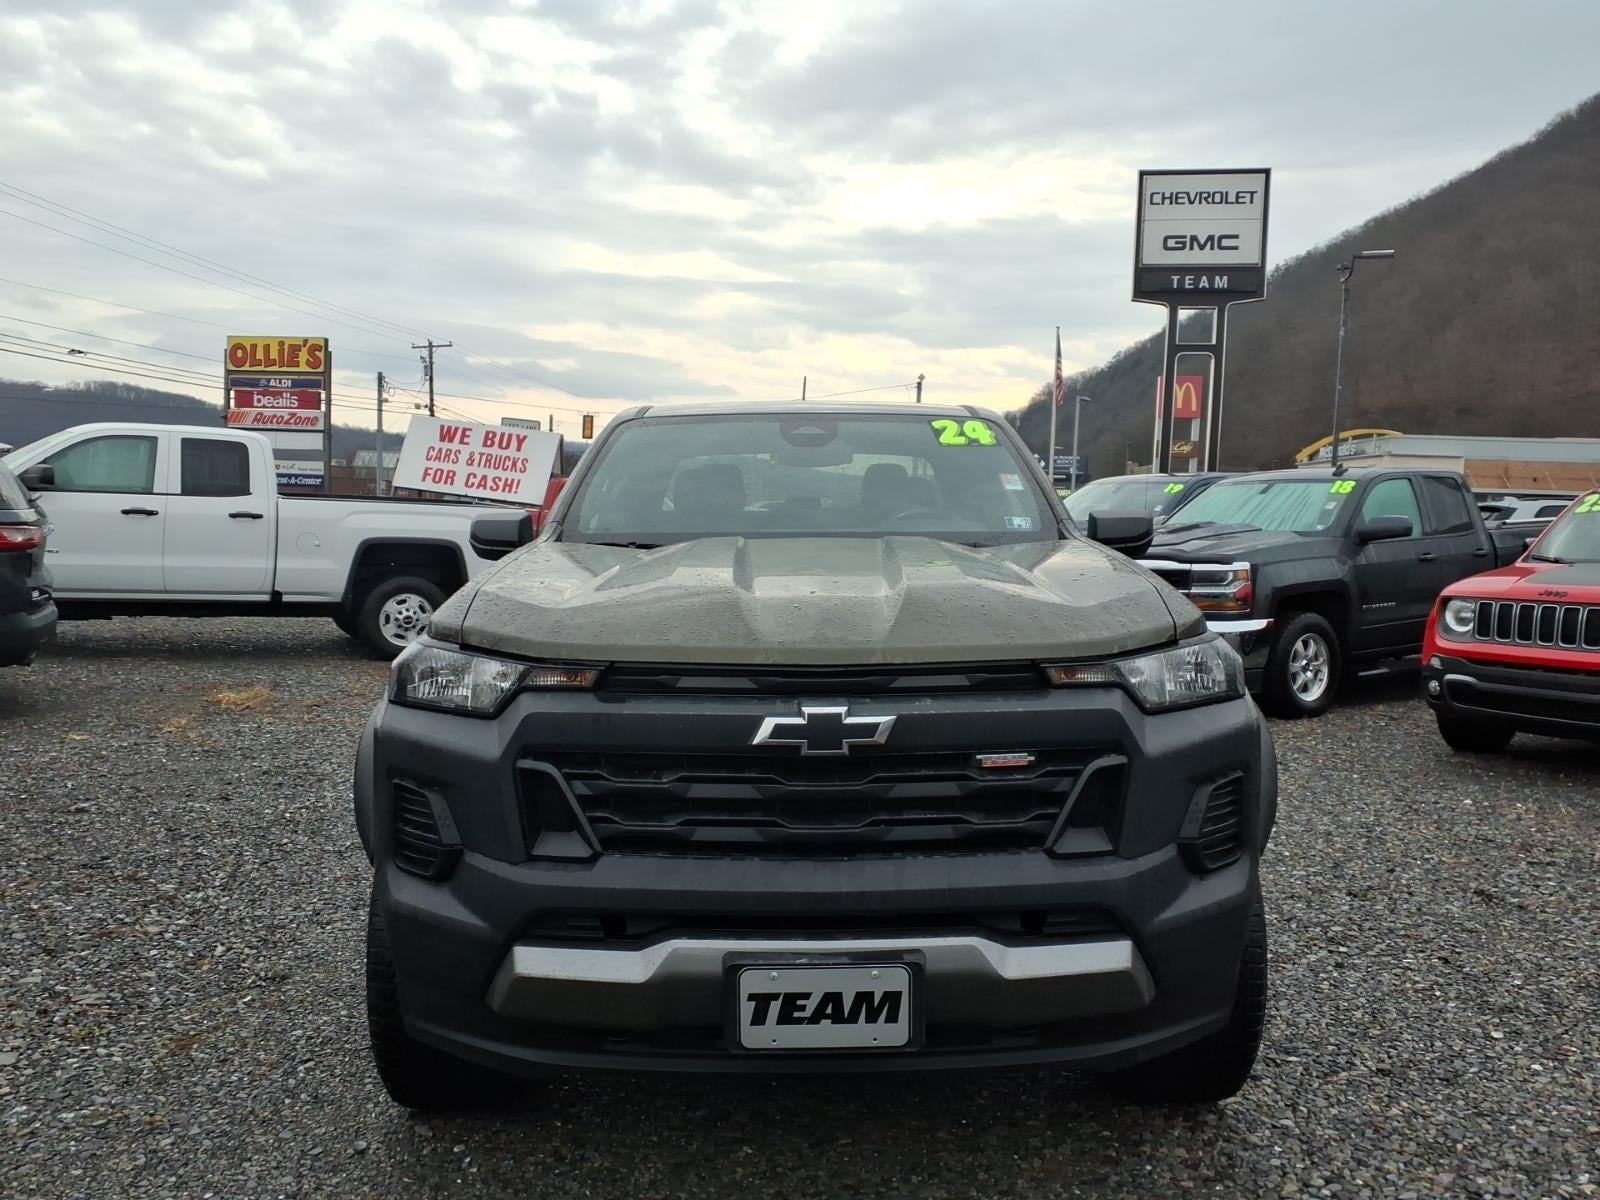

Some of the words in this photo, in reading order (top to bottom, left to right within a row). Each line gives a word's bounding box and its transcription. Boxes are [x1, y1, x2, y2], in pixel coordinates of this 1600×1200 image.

[1150, 190, 1258, 206] CHEVROLET
[1162, 234, 1240, 252] GMC
[1171, 275, 1228, 288] TEAM
[269, 378, 292, 388] ALDI
[254, 391, 299, 408] bealls
[252, 412, 320, 427] AutoZone
[438, 424, 472, 446] WE
[482, 430, 528, 452] BUY
[930, 418, 997, 446] 24
[426, 446, 462, 465] CARS
[277, 476, 322, 485] ent-A-Center
[422, 466, 457, 486] FOR
[464, 472, 522, 494] CASH!
[1329, 480, 1357, 494] 18
[1163, 483, 1184, 494] 19
[1538, 589, 1568, 598] Jeep
[746, 990, 902, 1026] TEAM
